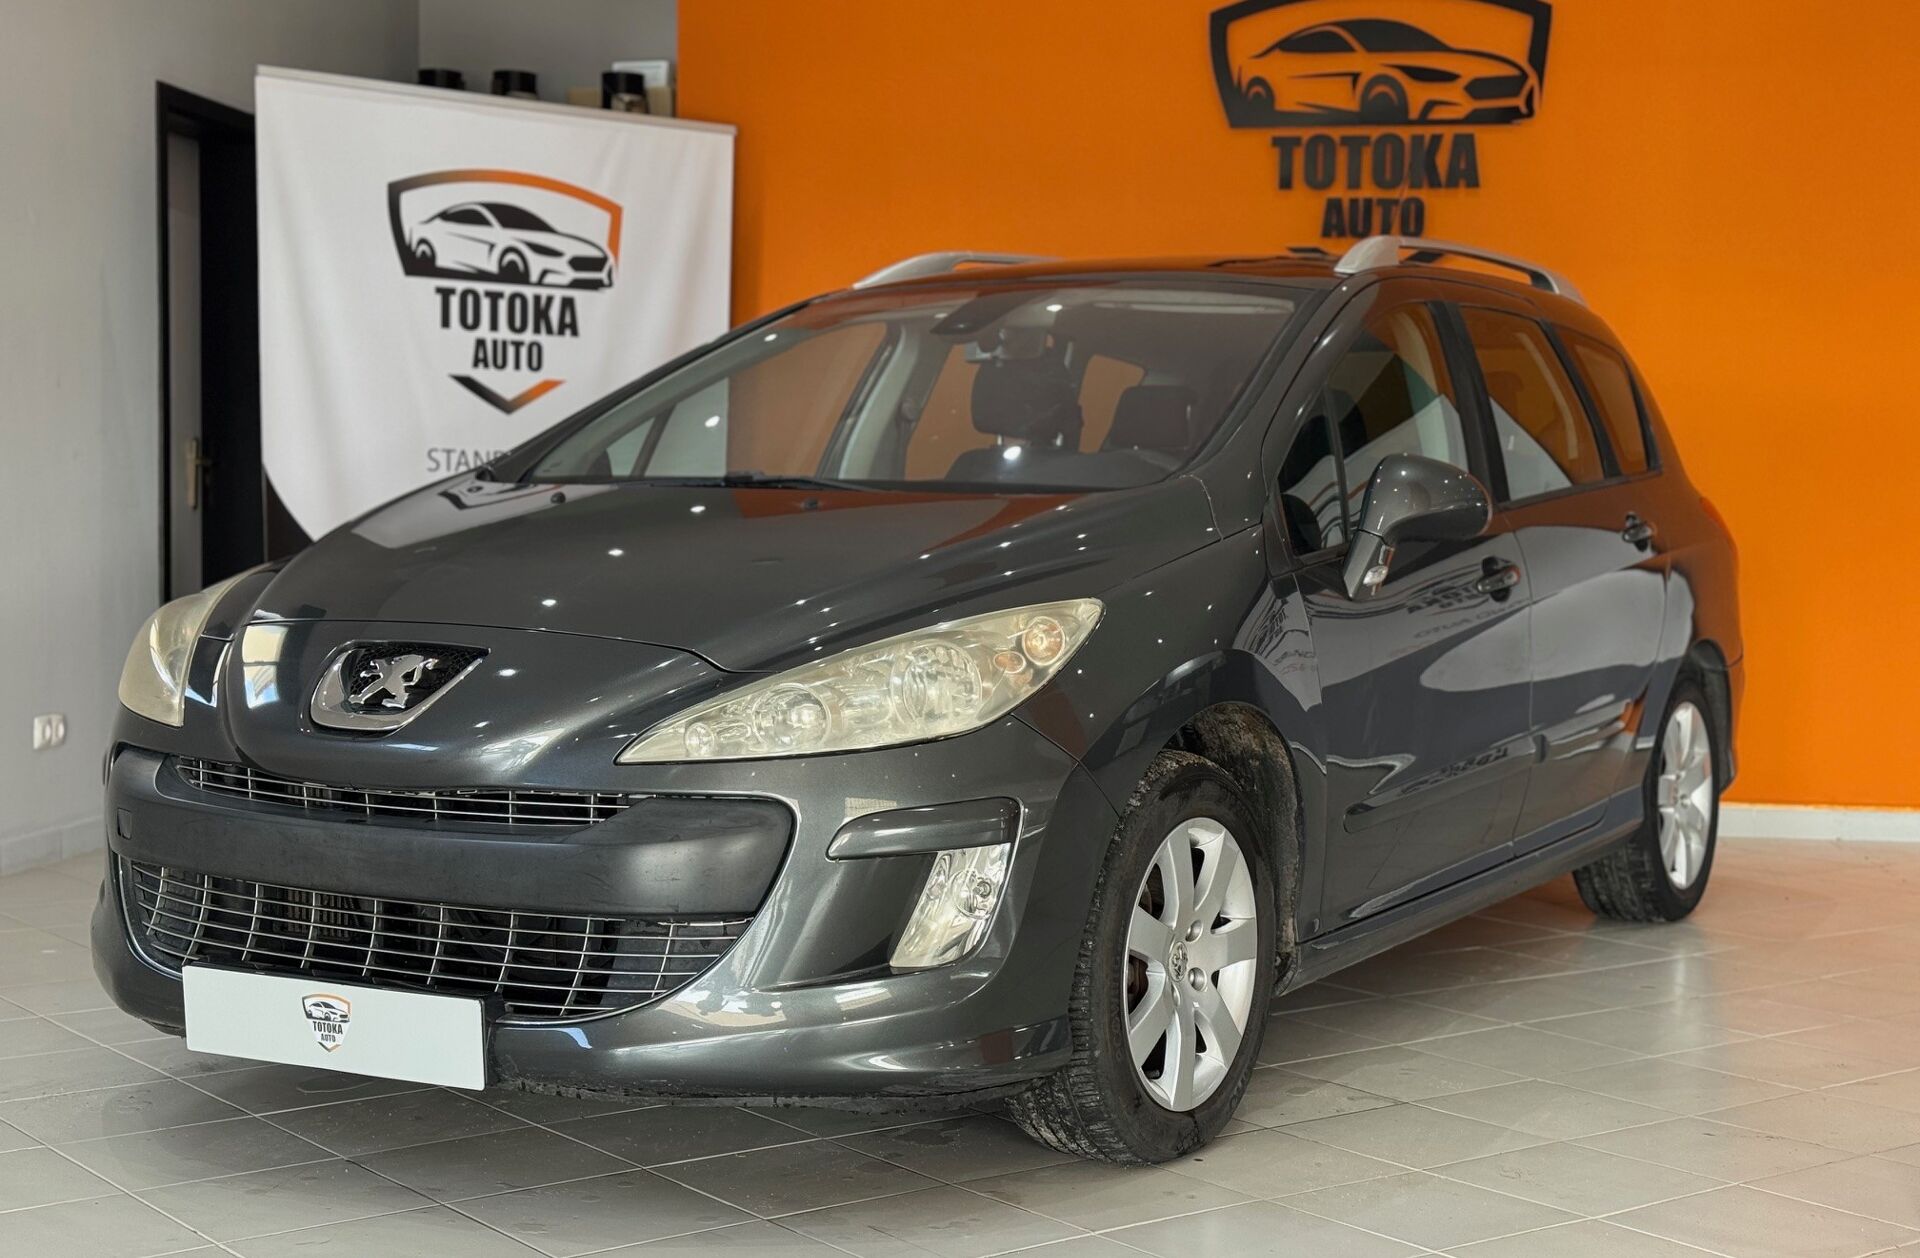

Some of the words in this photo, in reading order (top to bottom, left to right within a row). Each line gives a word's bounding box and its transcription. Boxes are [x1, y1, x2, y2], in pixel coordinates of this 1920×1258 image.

[1271, 133, 1480, 190] TOTOKA
[1321, 196, 1425, 239] AUTO
[435, 286, 579, 337] TOTOKA
[472, 337, 543, 372] AUTO
[312, 1020, 343, 1035] TOTOKA
[320, 1033, 336, 1043] AUTO
